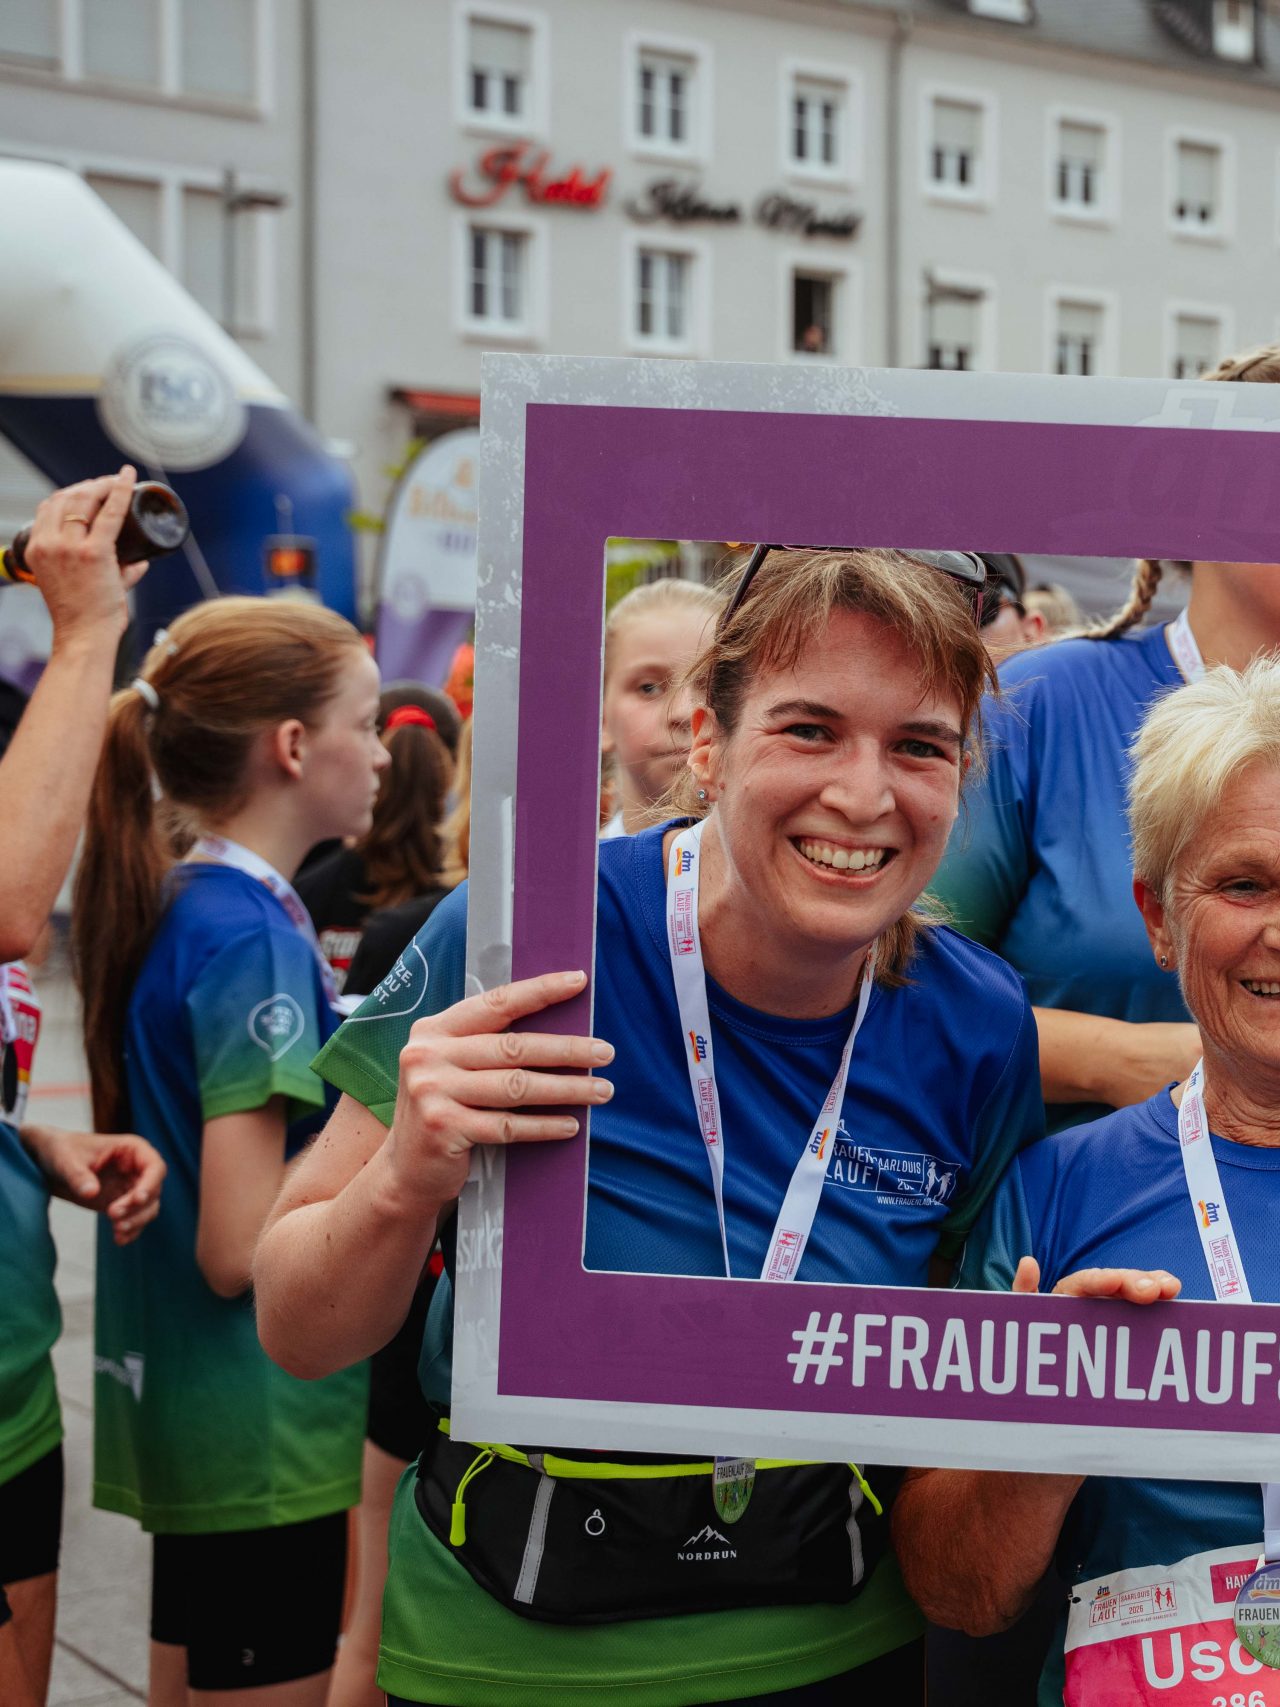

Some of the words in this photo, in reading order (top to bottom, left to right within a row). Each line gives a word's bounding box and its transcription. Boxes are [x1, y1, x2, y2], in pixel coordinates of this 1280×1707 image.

[682, 850, 695, 872] dm
[696, 1035, 708, 1059] dm
[809, 1131, 824, 1154] dm
[832, 1143, 874, 1164] RAUEN
[825, 1159, 874, 1185] AUF
[1206, 1202, 1220, 1223] dm
[1211, 1240, 1223, 1259] LAUF
[677, 1549, 738, 1561] NORDRUN
[1097, 1585, 1110, 1597] dm
[1255, 1574, 1280, 1591] dm
[1092, 1606, 1117, 1624] LAUF
[1120, 1589, 1150, 1603] SAARLOUIS
[1093, 1598, 1117, 1612] FRAUEN
[1128, 1604, 1144, 1615] 2026
